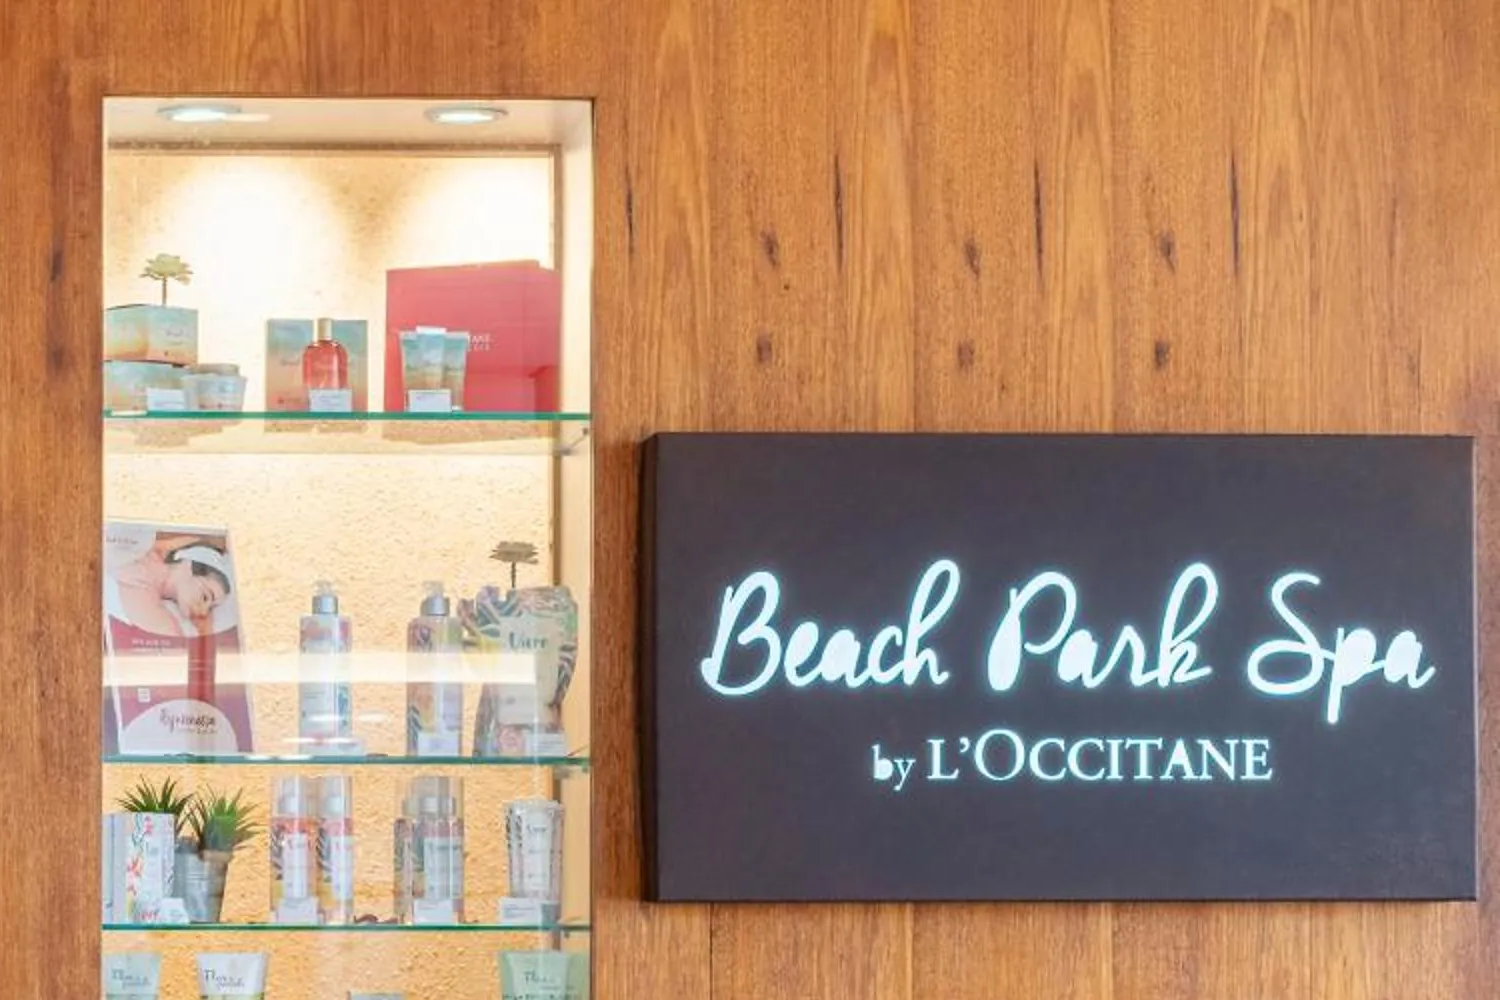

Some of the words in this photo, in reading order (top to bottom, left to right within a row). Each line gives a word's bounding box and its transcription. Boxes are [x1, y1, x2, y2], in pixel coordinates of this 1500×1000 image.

[700, 559, 961, 696] Beach
[987, 562, 1220, 692] Park
[1246, 571, 1436, 725] Spa
[872, 744, 916, 791] by
[927, 728, 1273, 782] L'OCCITANE
